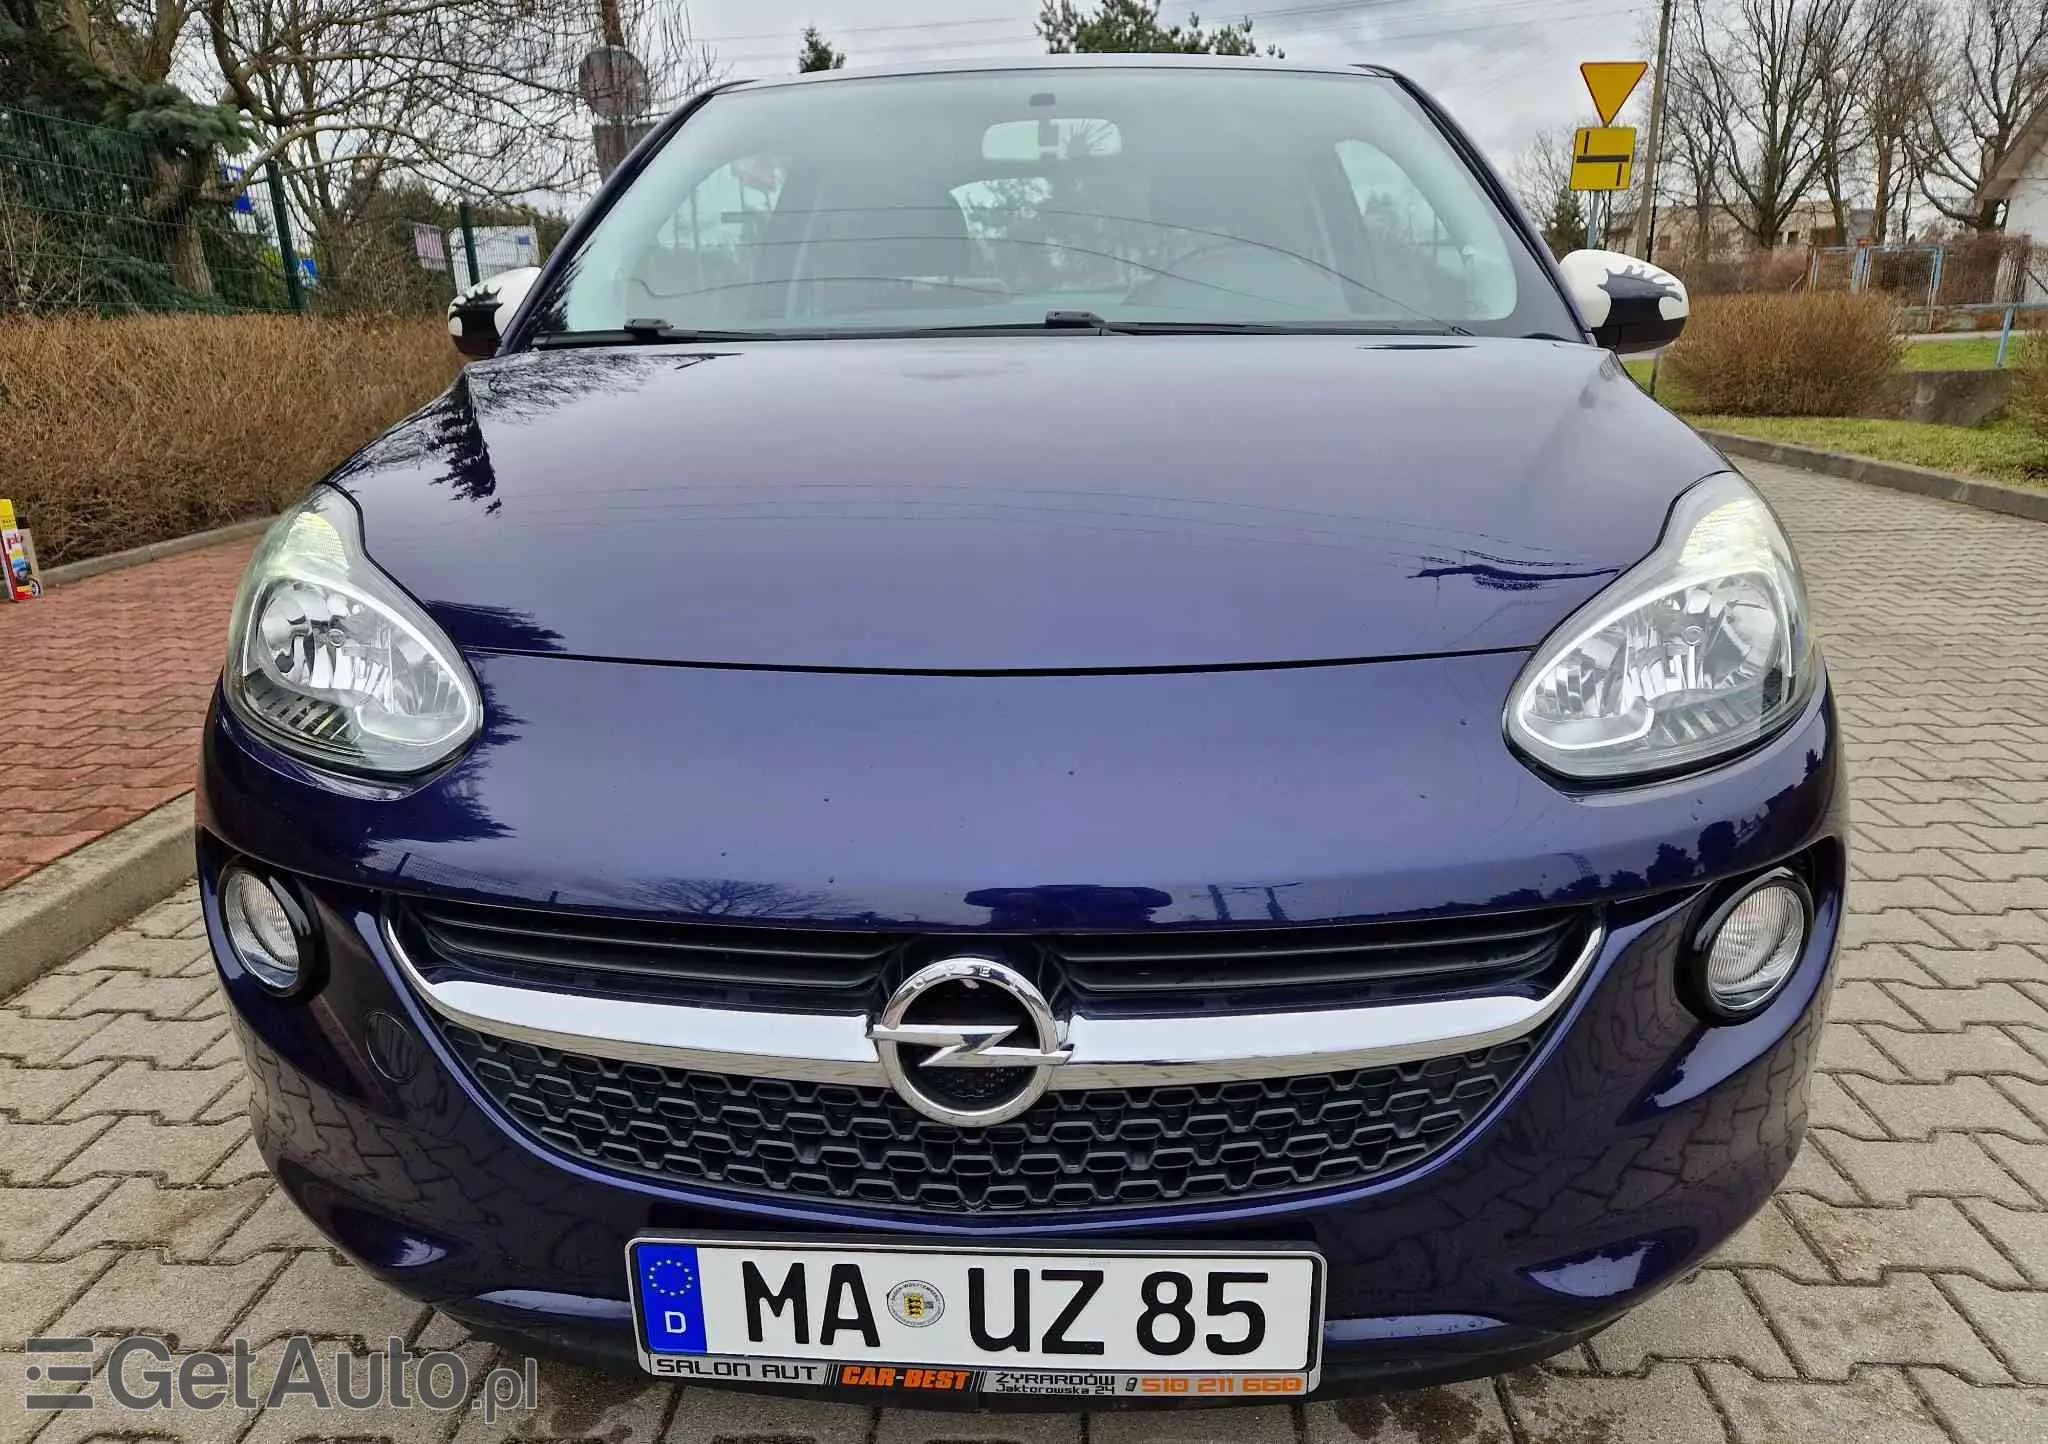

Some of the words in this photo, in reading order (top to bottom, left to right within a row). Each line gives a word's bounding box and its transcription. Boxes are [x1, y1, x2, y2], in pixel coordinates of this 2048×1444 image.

[742, 1260, 881, 1348] MA
[967, 1267, 1105, 1355] UZ
[1136, 1271, 1269, 1356] 85
[665, 1311, 686, 1334] D
[656, 1358, 750, 1377] SALON
[761, 1364, 818, 1381] AUT
[841, 1366, 972, 1390] CAR-BEST
[995, 1383, 1090, 1395] Jaktorowska
[1095, 1385, 1115, 1395] 24
[1141, 1376, 1189, 1393] 510
[1198, 1376, 1235, 1393] 211
[1242, 1376, 1304, 1393] 660
